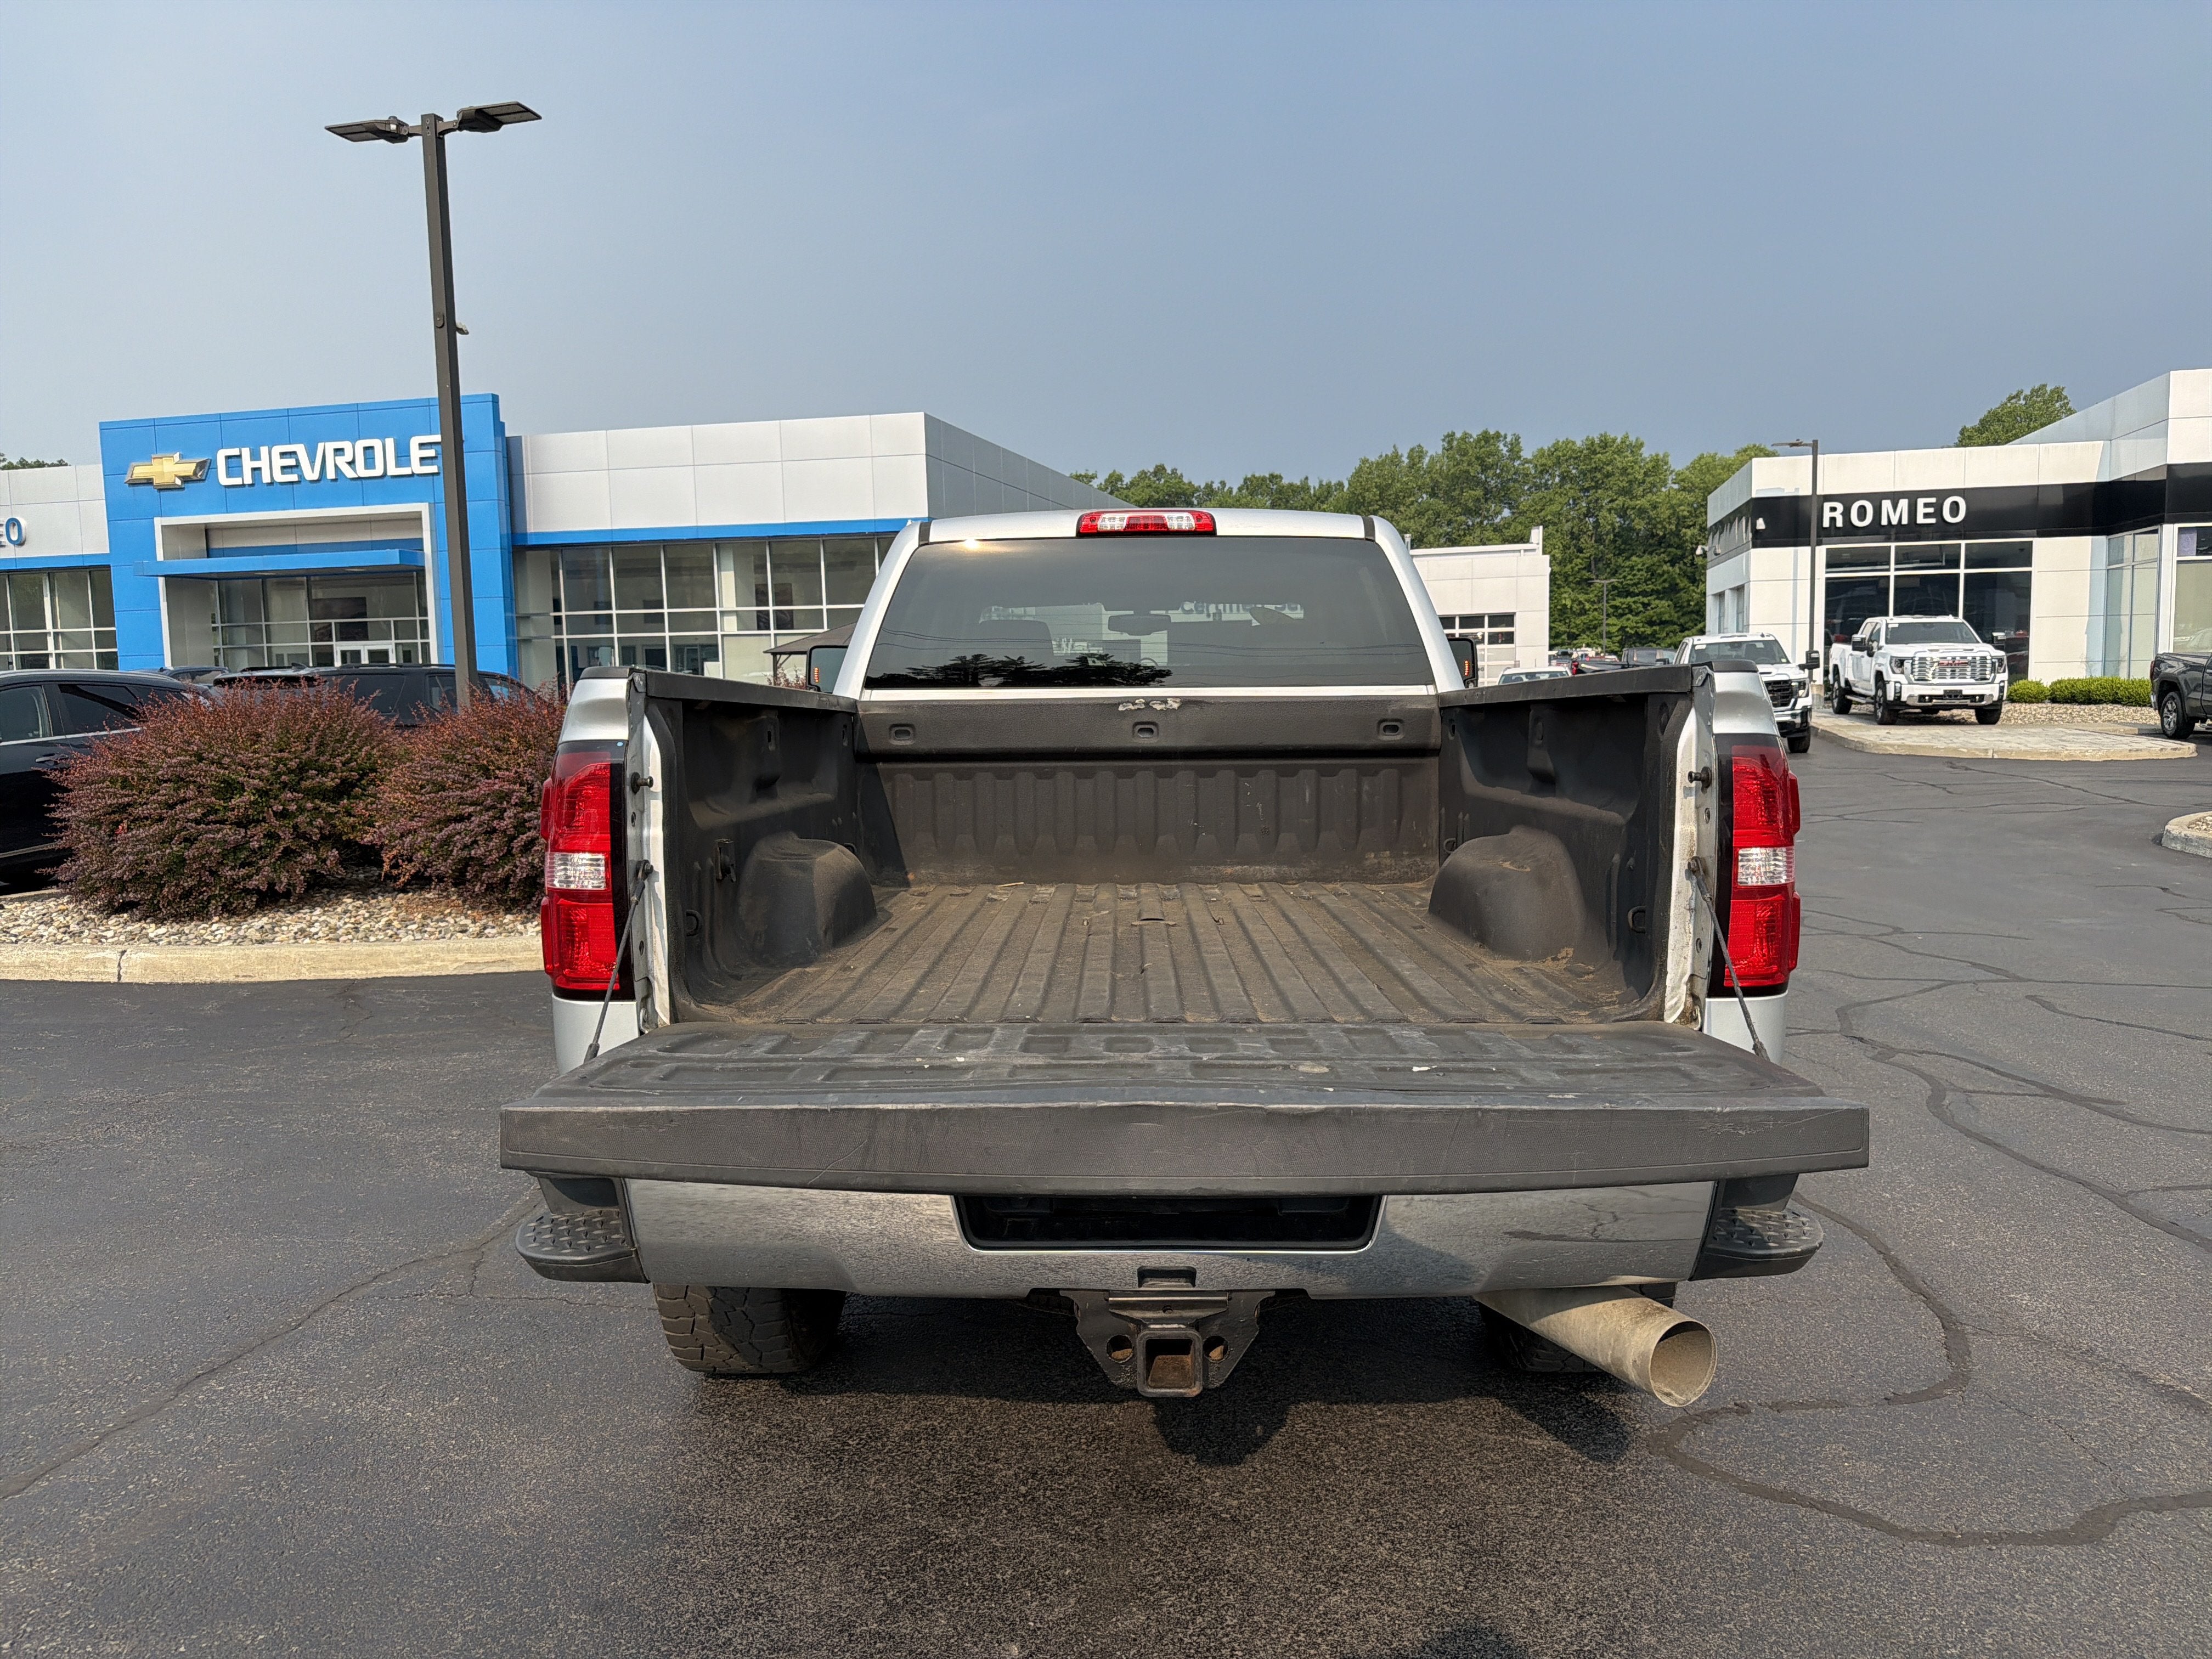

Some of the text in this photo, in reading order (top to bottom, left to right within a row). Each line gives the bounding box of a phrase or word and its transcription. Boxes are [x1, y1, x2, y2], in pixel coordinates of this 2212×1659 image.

[217, 435, 442, 486] CHEVROLE
[1822, 496, 1966, 528] ROMEO
[0, 517, 26, 546] O
